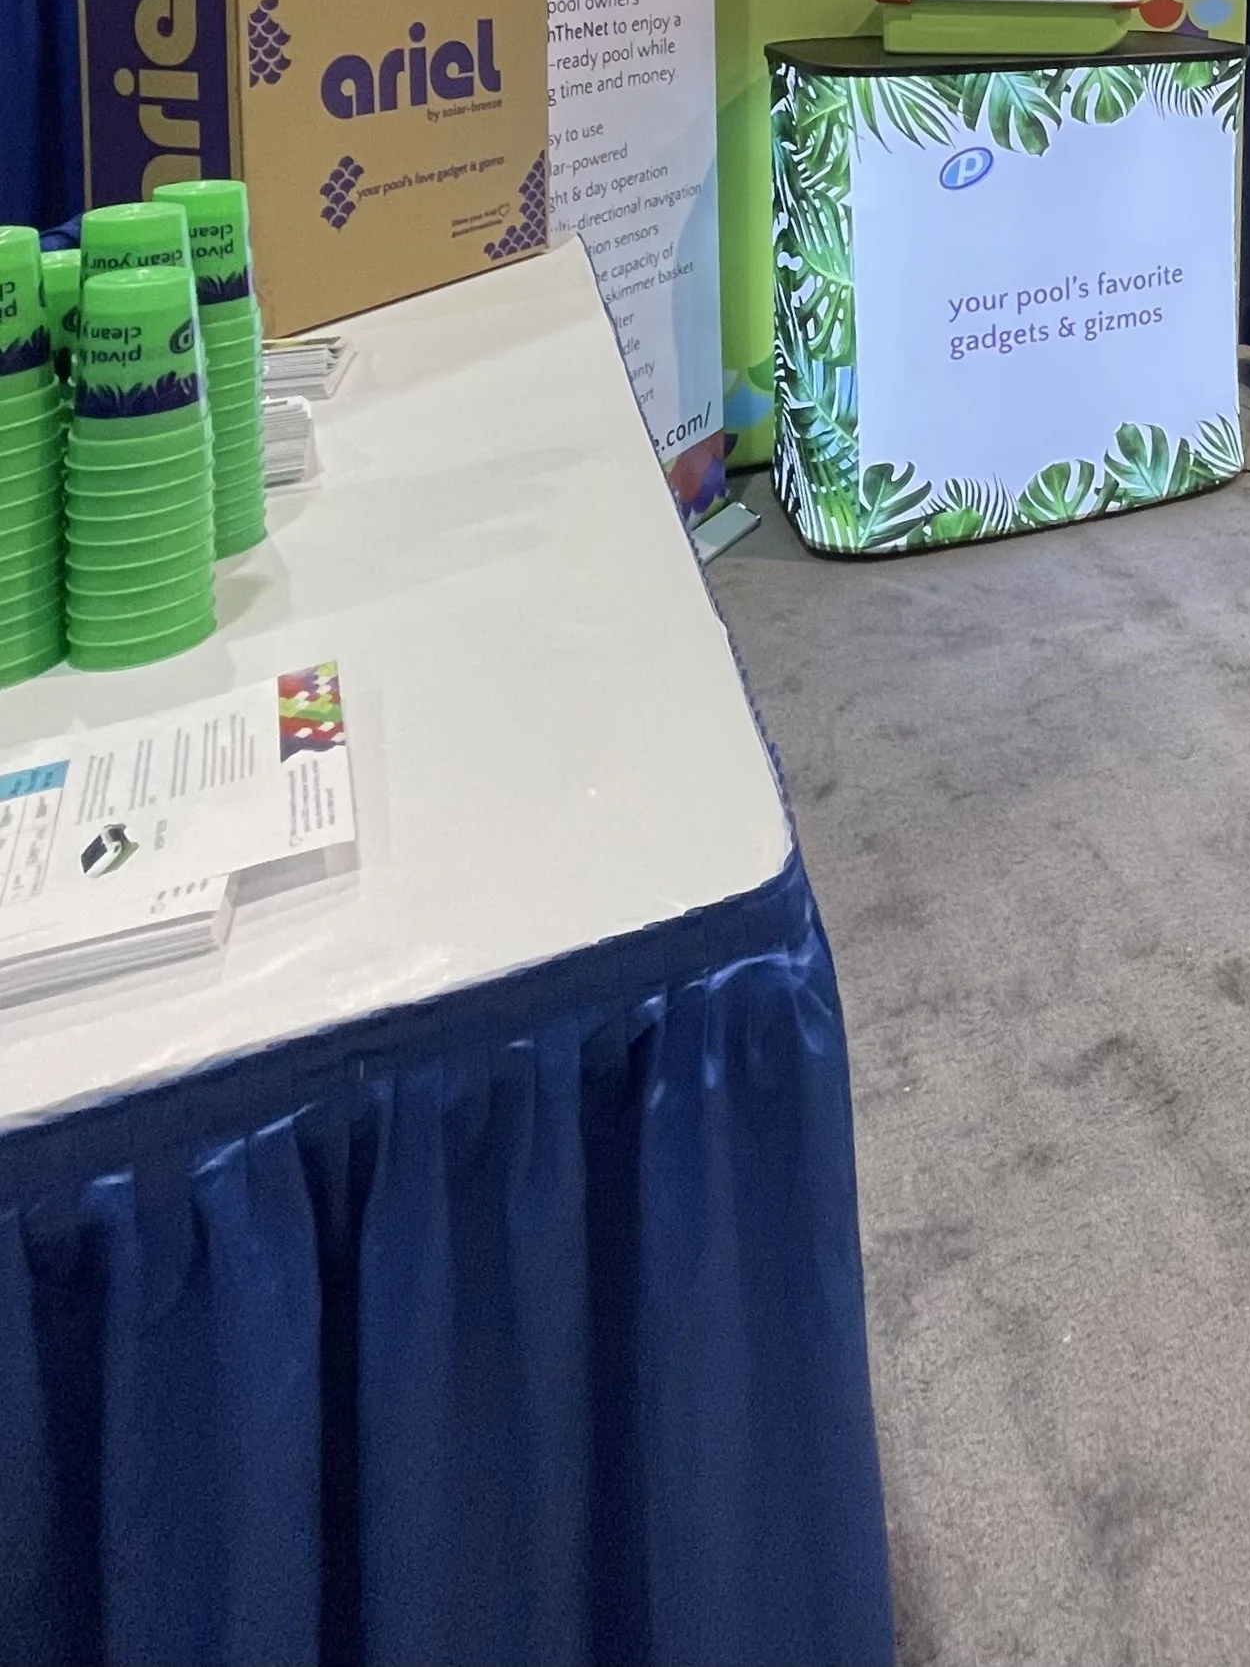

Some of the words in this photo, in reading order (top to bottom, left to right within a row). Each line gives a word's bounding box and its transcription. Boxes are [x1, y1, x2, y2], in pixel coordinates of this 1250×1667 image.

[613, 20, 627, 34] to
[631, 13, 671, 35] enjoy
[673, 15, 682, 28] a
[320, 18, 502, 120] ariel
[602, 41, 634, 69] pool
[637, 37, 676, 57] while
[560, 81, 593, 99] time
[597, 70, 624, 92] and
[426, 106, 440, 123] by
[442, 99, 503, 118] solar-breeze
[565, 127, 579, 142] to
[582, 123, 604, 139] use
[549, 142, 629, 177] lar-powered
[357, 184, 380, 203] your
[382, 174, 413, 196] pool's
[437, 165, 468, 183] gadget
[571, 186, 582, 202] &
[585, 181, 608, 199] day
[611, 165, 669, 194] operation
[643, 183, 702, 208] navigation
[614, 224, 660, 248] sensors
[611, 252, 661, 279] capacity
[662, 241, 675, 258] of
[605, 276, 655, 304] skimmer
[658, 261, 695, 284] basket
[948, 291, 1009, 323] your
[1016, 276, 1089, 315] pool's
[1097, 265, 1184, 297] favorite
[90, 325, 142, 344] clean
[949, 324, 1050, 360] gadgets
[1057, 317, 1077, 339] &
[1084, 306, 1164, 342] gizmos
